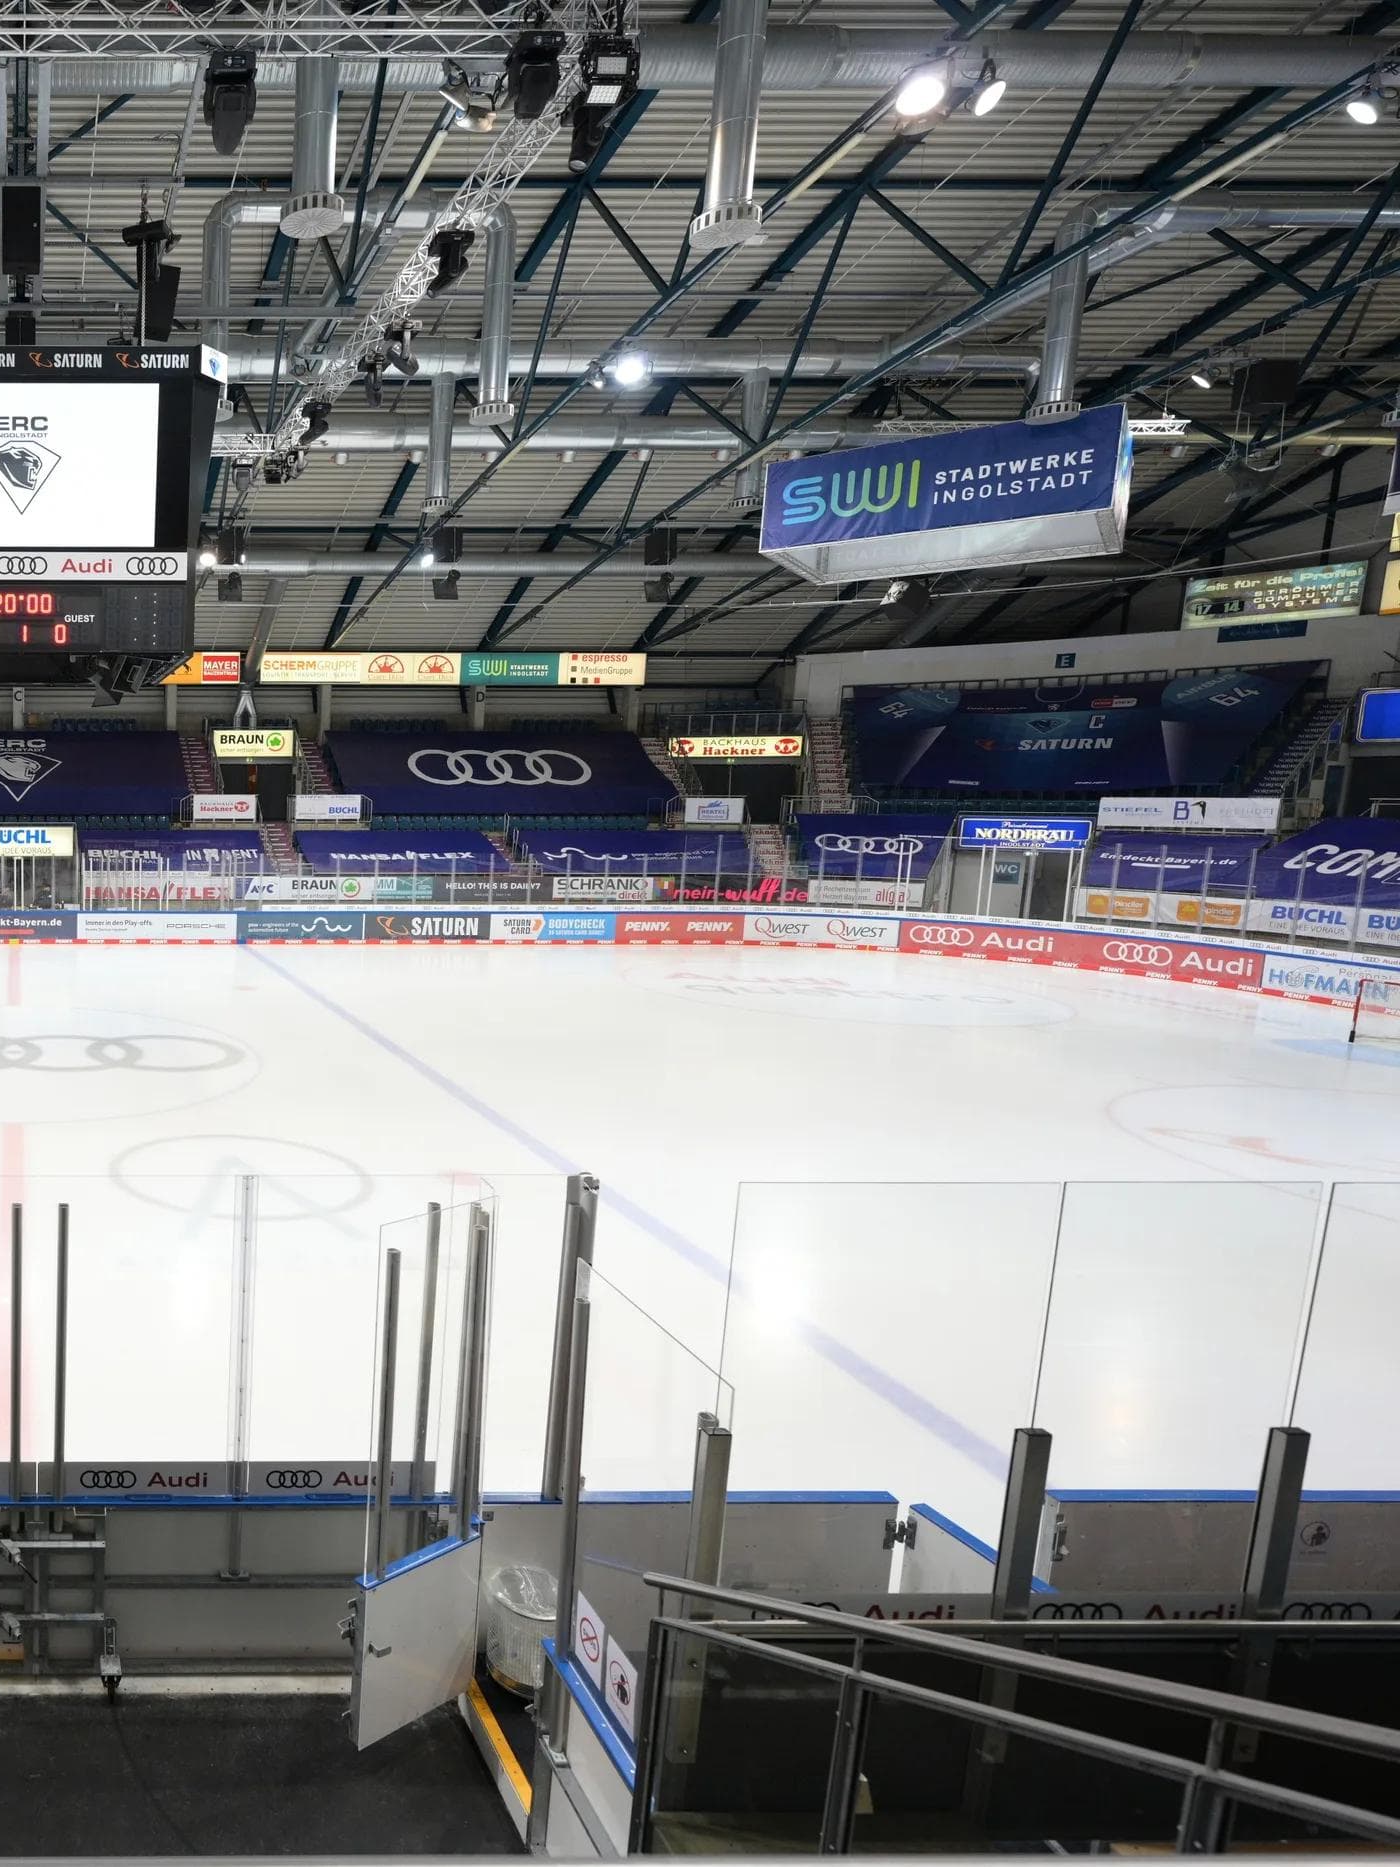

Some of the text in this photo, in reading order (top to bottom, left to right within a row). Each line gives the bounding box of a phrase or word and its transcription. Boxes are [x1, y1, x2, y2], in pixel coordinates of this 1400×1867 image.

[54, 352, 102, 368] SATURN
[140, 352, 188, 368] SATURN
[935, 448, 1095, 485] STADTWERKE
[933, 470, 1094, 504] INGOLSTADT
[61, 558, 113, 574] Audi
[1195, 580, 1230, 592] Zeit
[1234, 578, 1261, 590] für
[1267, 574, 1294, 586] die
[1253, 588, 1359, 603] COMPUTER
[1256, 595, 1352, 610] SYSTEME
[64, 614, 95, 623] GUEST
[21, 626, 28, 642] 1
[55, 624, 67, 643] 0
[203, 661, 238, 670] MAYER
[581, 654, 628, 664] espresso
[581, 666, 633, 676] MedienGruppe
[14, 691, 23, 701] C
[476, 691, 485, 703] D
[1208, 687, 1260, 707] 64
[878, 702, 915, 718] 64
[1089, 715, 1105, 729] C
[220, 734, 264, 745] BRAUN
[703, 738, 766, 746] BACKHAUS
[1018, 737, 1113, 750] SATURN
[703, 746, 766, 756] Hackner
[328, 805, 359, 814] BÜCHL
[1102, 806, 1163, 814] STIEFEL
[995, 864, 1019, 875] WC
[292, 880, 337, 890] BRAUN
[411, 917, 478, 936] SATURN
[503, 919, 531, 927] SATURN
[549, 918, 605, 929] BODYCHECK
[624, 921, 670, 933] PENNY.
[687, 921, 734, 933] PENNY.
[981, 932, 1054, 953] Audi
[1180, 951, 1253, 977] Audi
[147, 1471, 208, 1488] Audi
